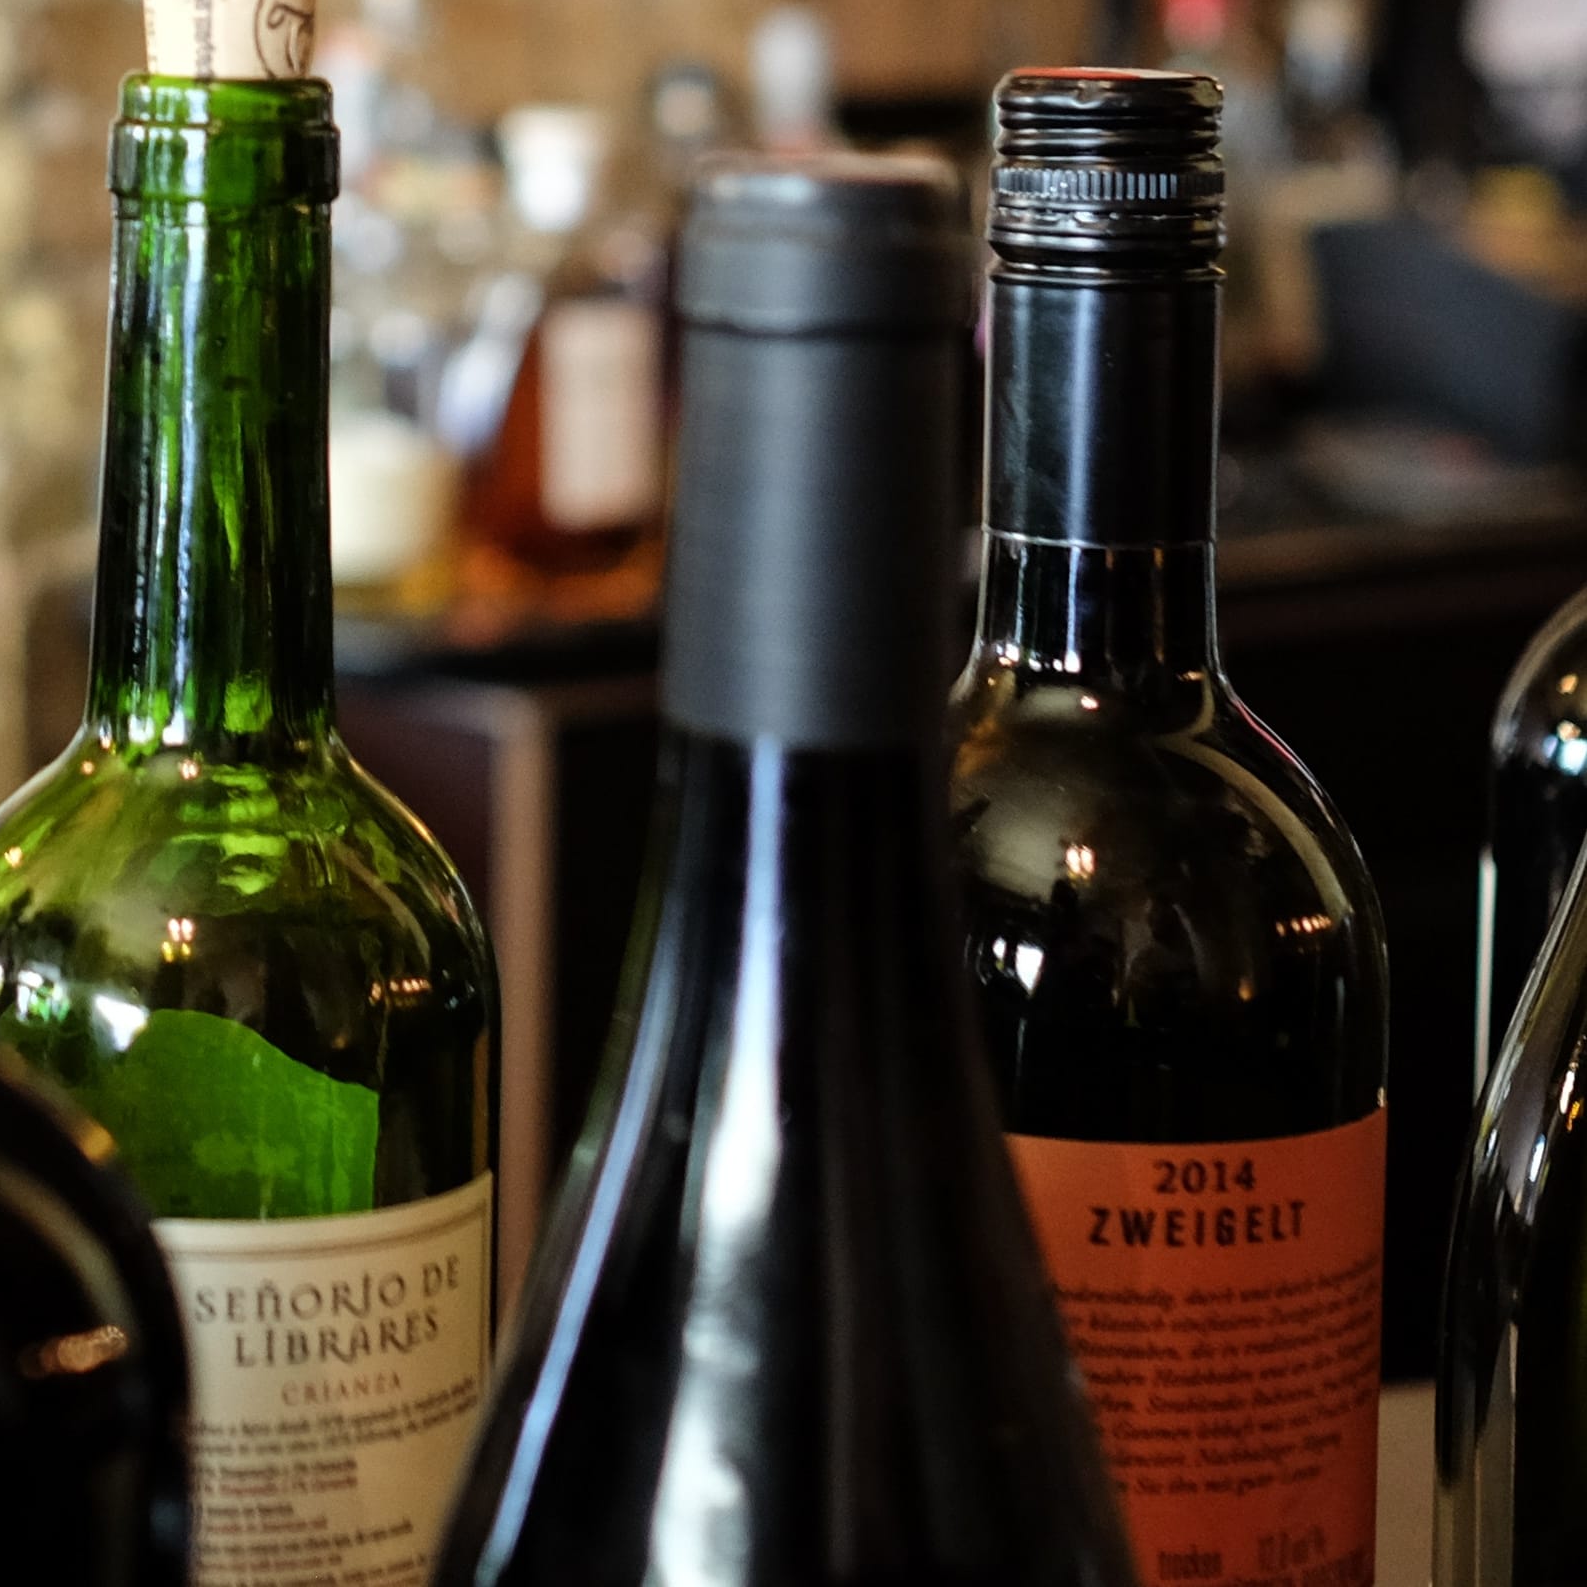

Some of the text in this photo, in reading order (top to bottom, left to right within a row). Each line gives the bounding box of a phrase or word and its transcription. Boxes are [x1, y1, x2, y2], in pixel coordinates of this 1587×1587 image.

[1154, 1159, 1256, 1194] 2014
[1088, 1201, 1305, 1247] ZWEIGELT
[422, 1254, 460, 1298] DE
[235, 1310, 439, 1367] LIBRARES
